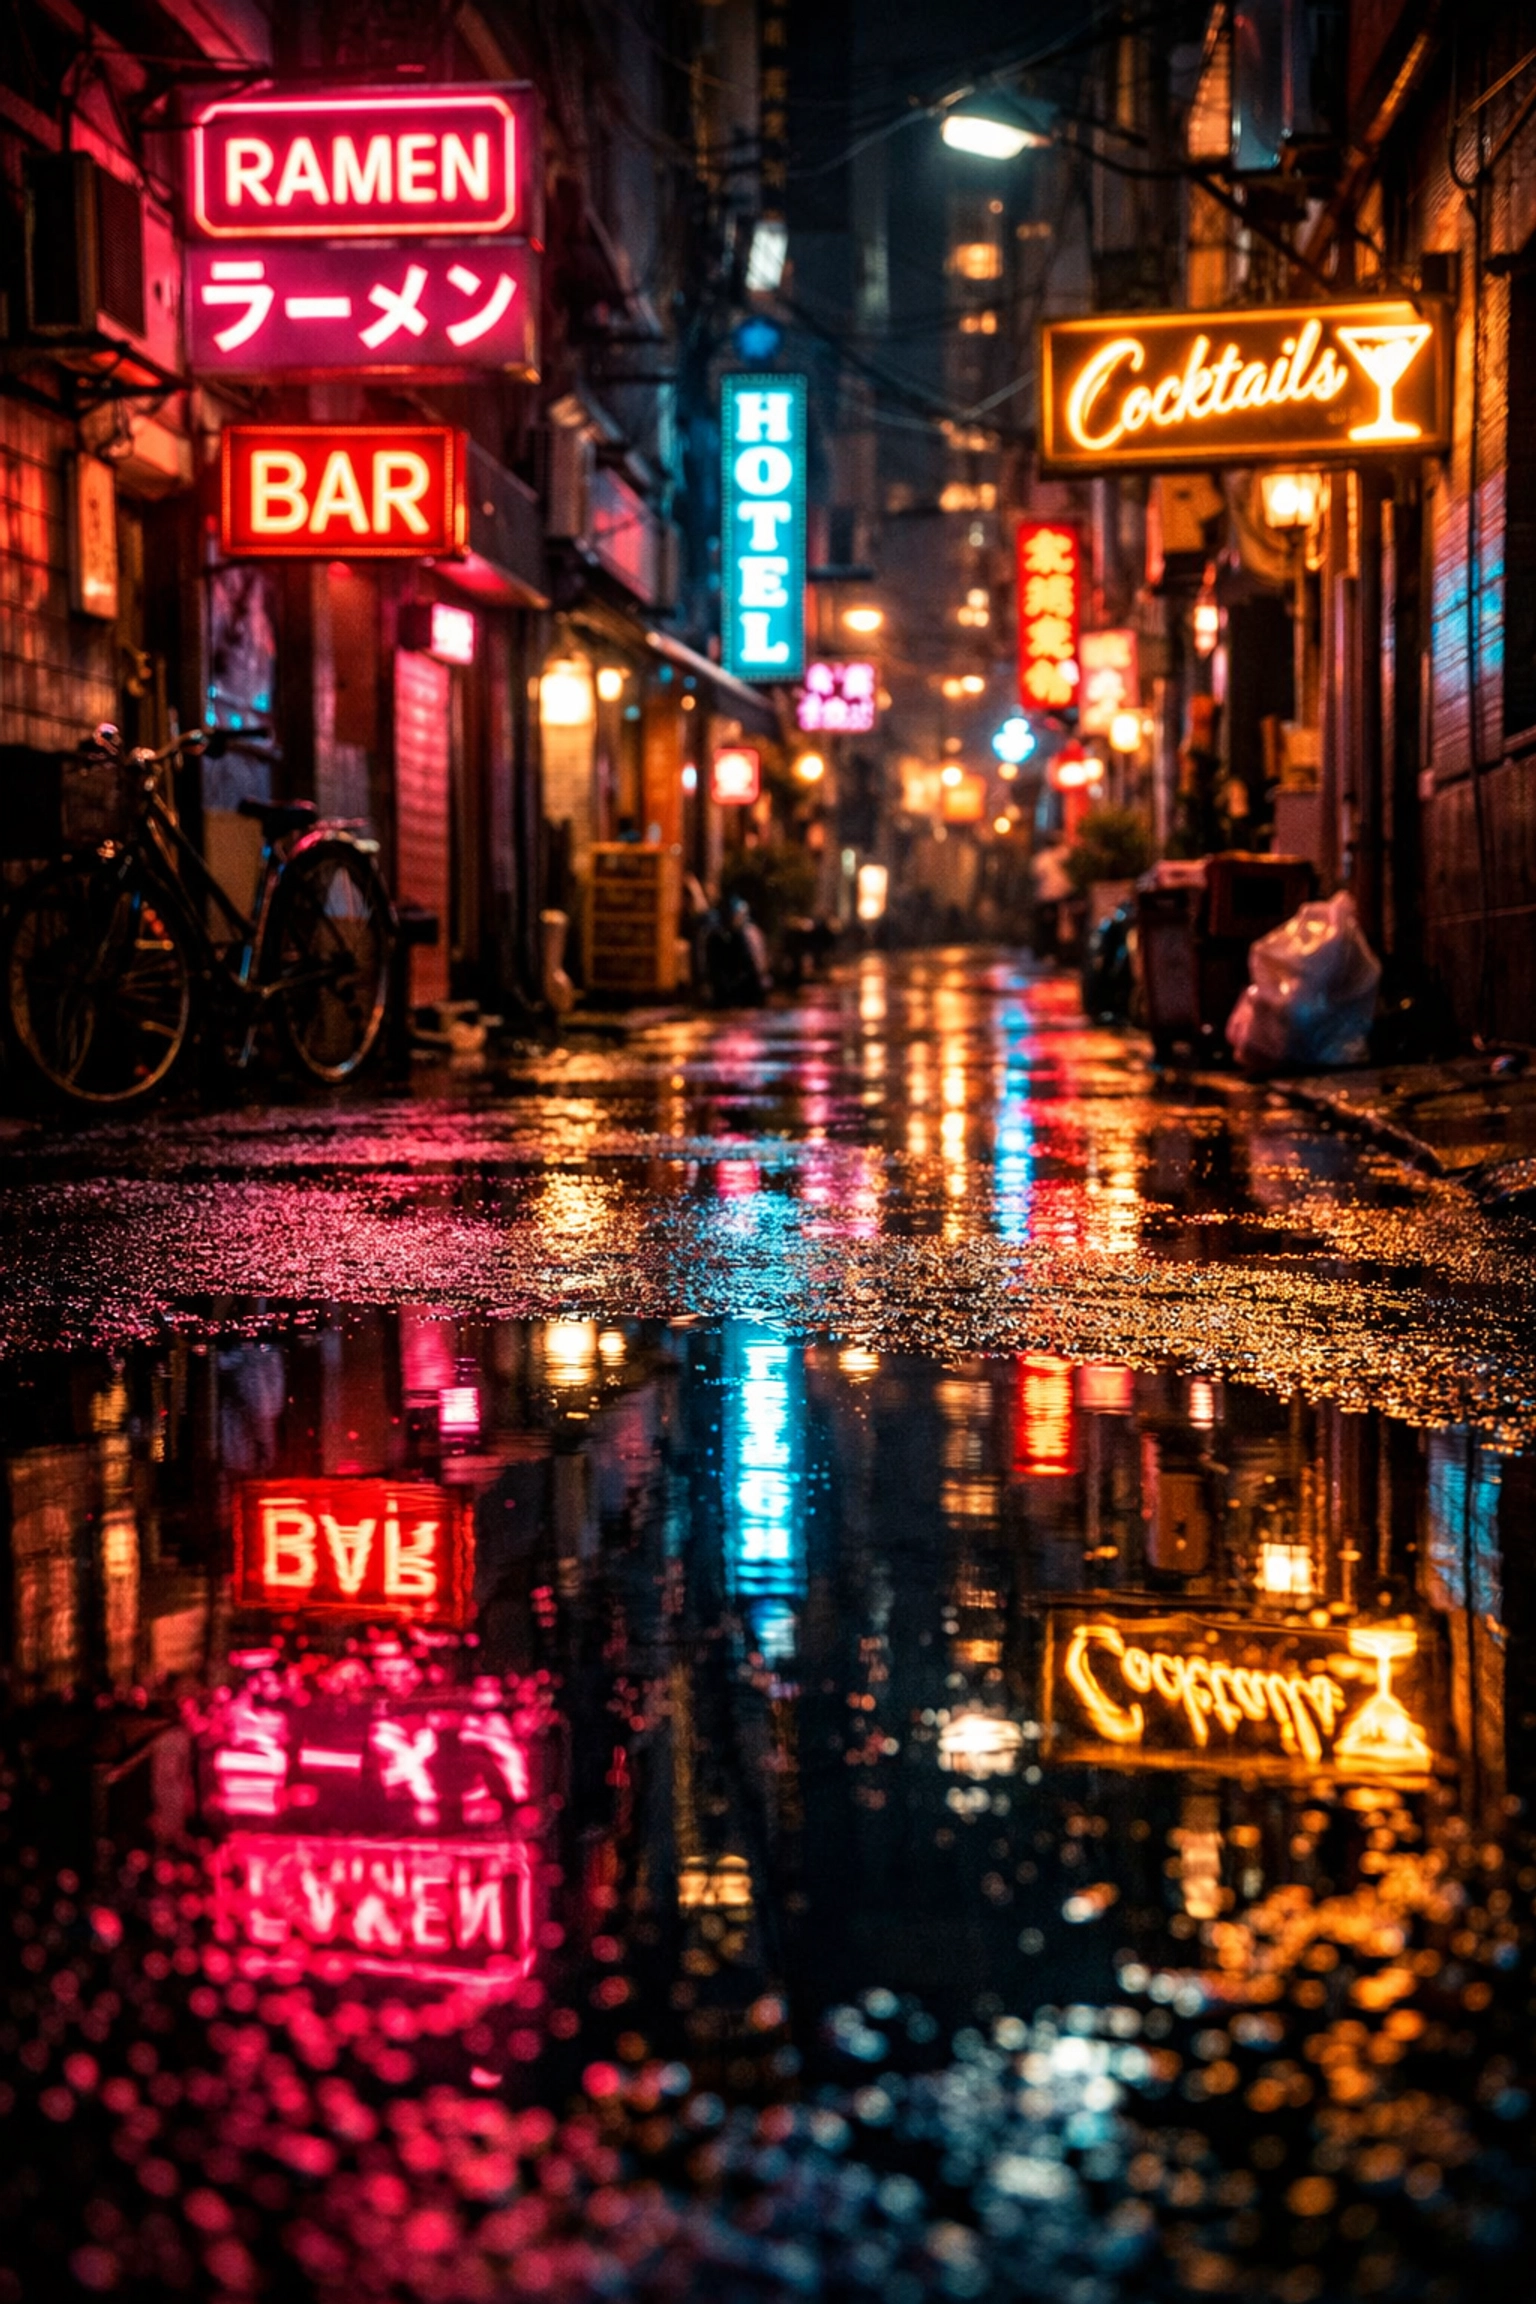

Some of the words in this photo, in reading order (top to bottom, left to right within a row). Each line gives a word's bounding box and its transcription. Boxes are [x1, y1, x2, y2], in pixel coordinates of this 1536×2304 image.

[224, 132, 490, 206] RAMEN
[200, 260, 517, 352] ラーメン
[1065, 317, 1349, 451] Cocktails
[250, 449, 430, 535] BAR
[734, 391, 794, 664] HOTEL
